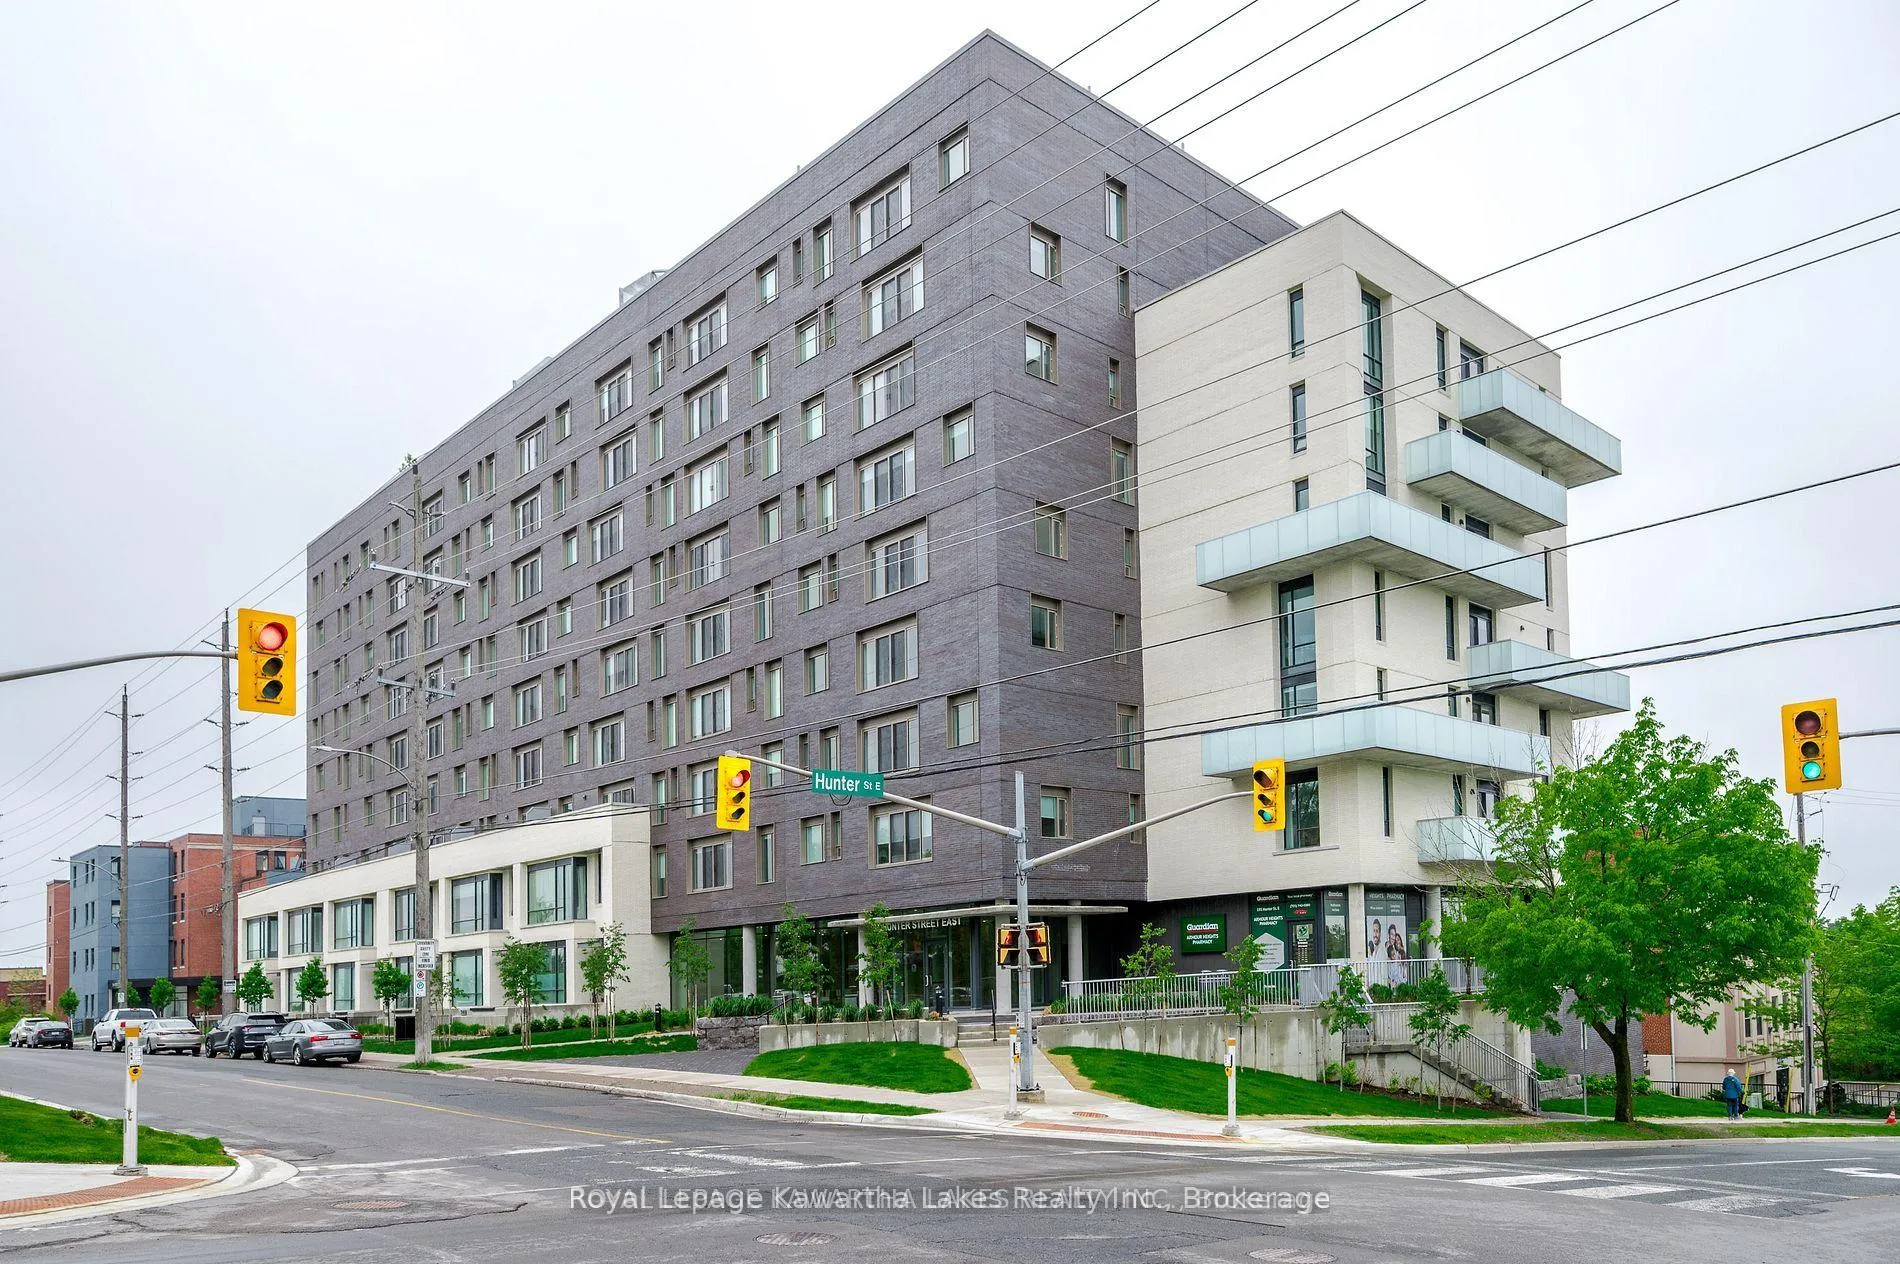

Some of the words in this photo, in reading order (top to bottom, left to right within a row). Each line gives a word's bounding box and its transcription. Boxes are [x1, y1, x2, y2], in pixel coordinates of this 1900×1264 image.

[815, 772, 861, 792] Hunter
[863, 780, 872, 790] St
[875, 781, 881, 791] E
[886, 920, 911, 931] UNTER
[912, 918, 940, 930] STREET
[941, 916, 961, 927] EAST
[1186, 922, 1219, 931] Guardian
